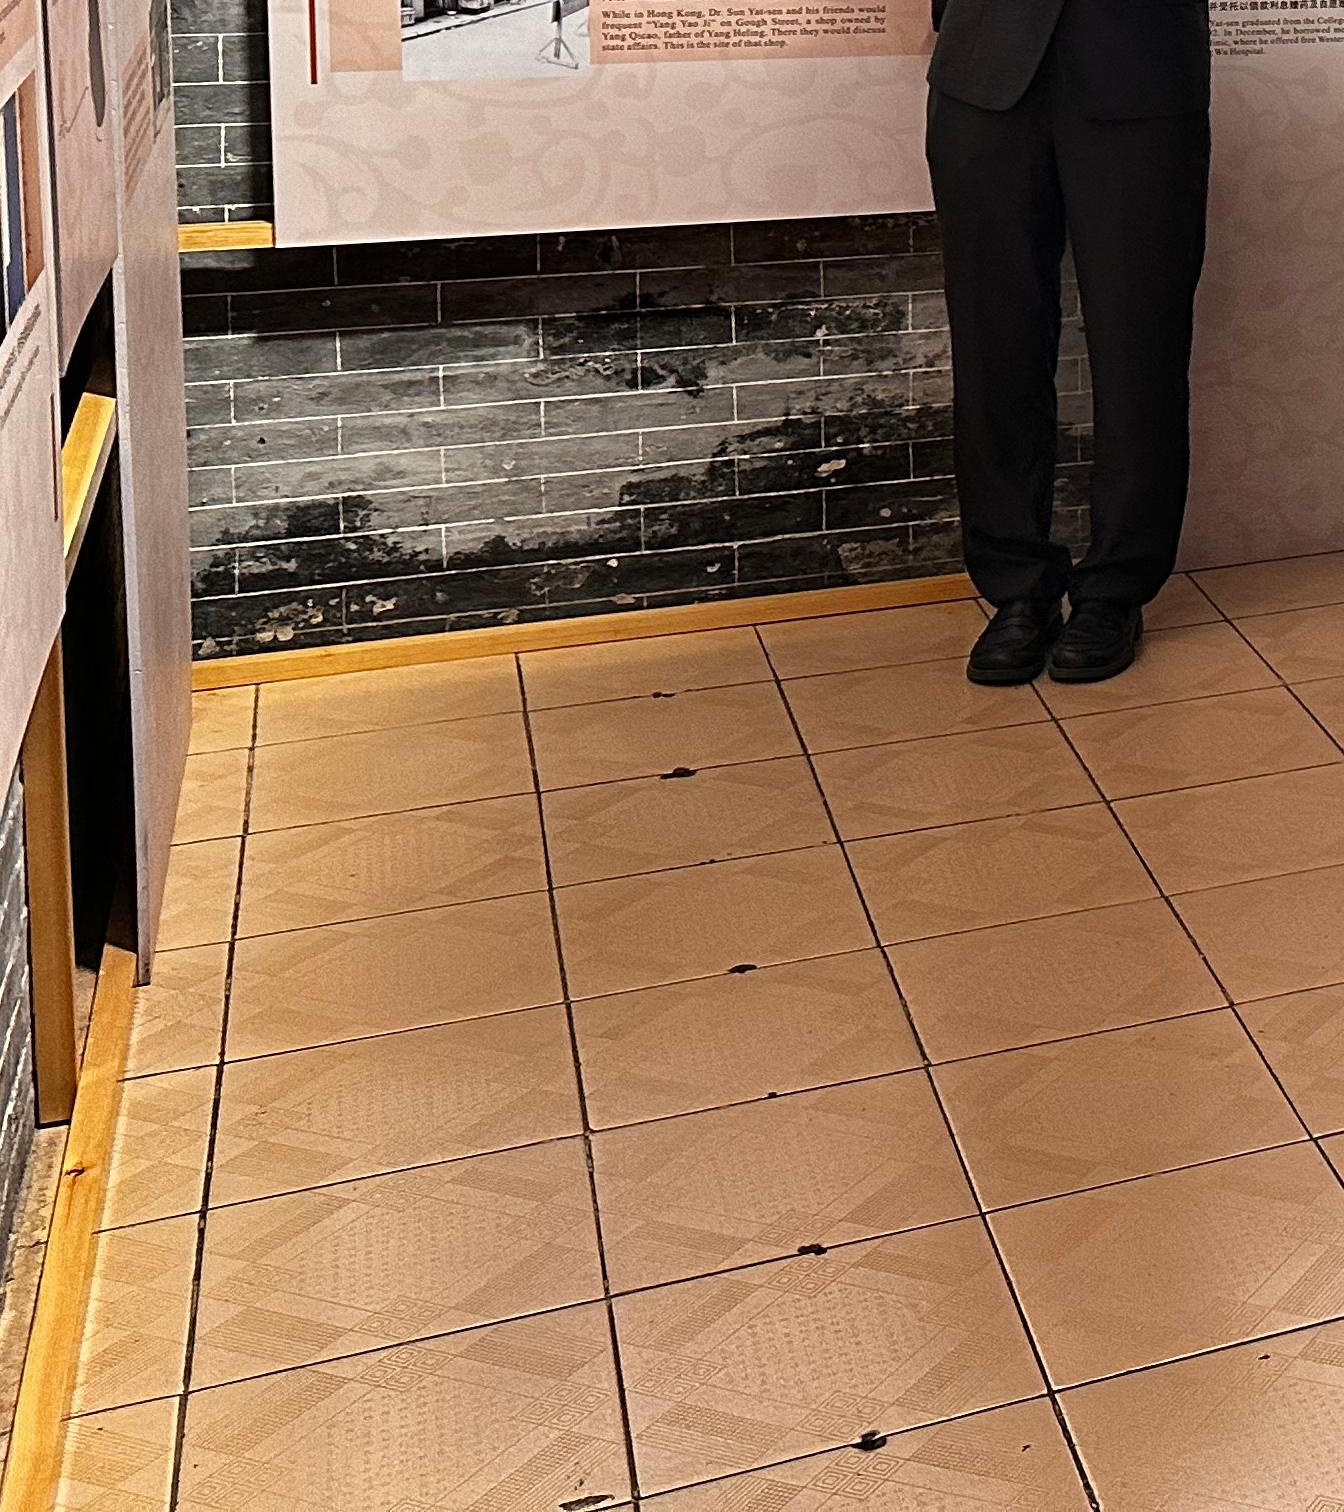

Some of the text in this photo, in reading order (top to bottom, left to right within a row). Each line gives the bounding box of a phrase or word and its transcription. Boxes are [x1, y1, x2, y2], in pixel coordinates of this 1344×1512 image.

[601, 9, 631, 19] While
[633, 9, 644, 19] in
[646, 9, 674, 19] Hong
[675, 8, 706, 19] Kong,
[708, 8, 723, 17] Dr.
[726, 7, 746, 17] Sun
[784, 5, 803, 15] and
[805, 6, 820, 15] his
[822, 4, 855, 15] friends
[857, 4, 887, 13] would
